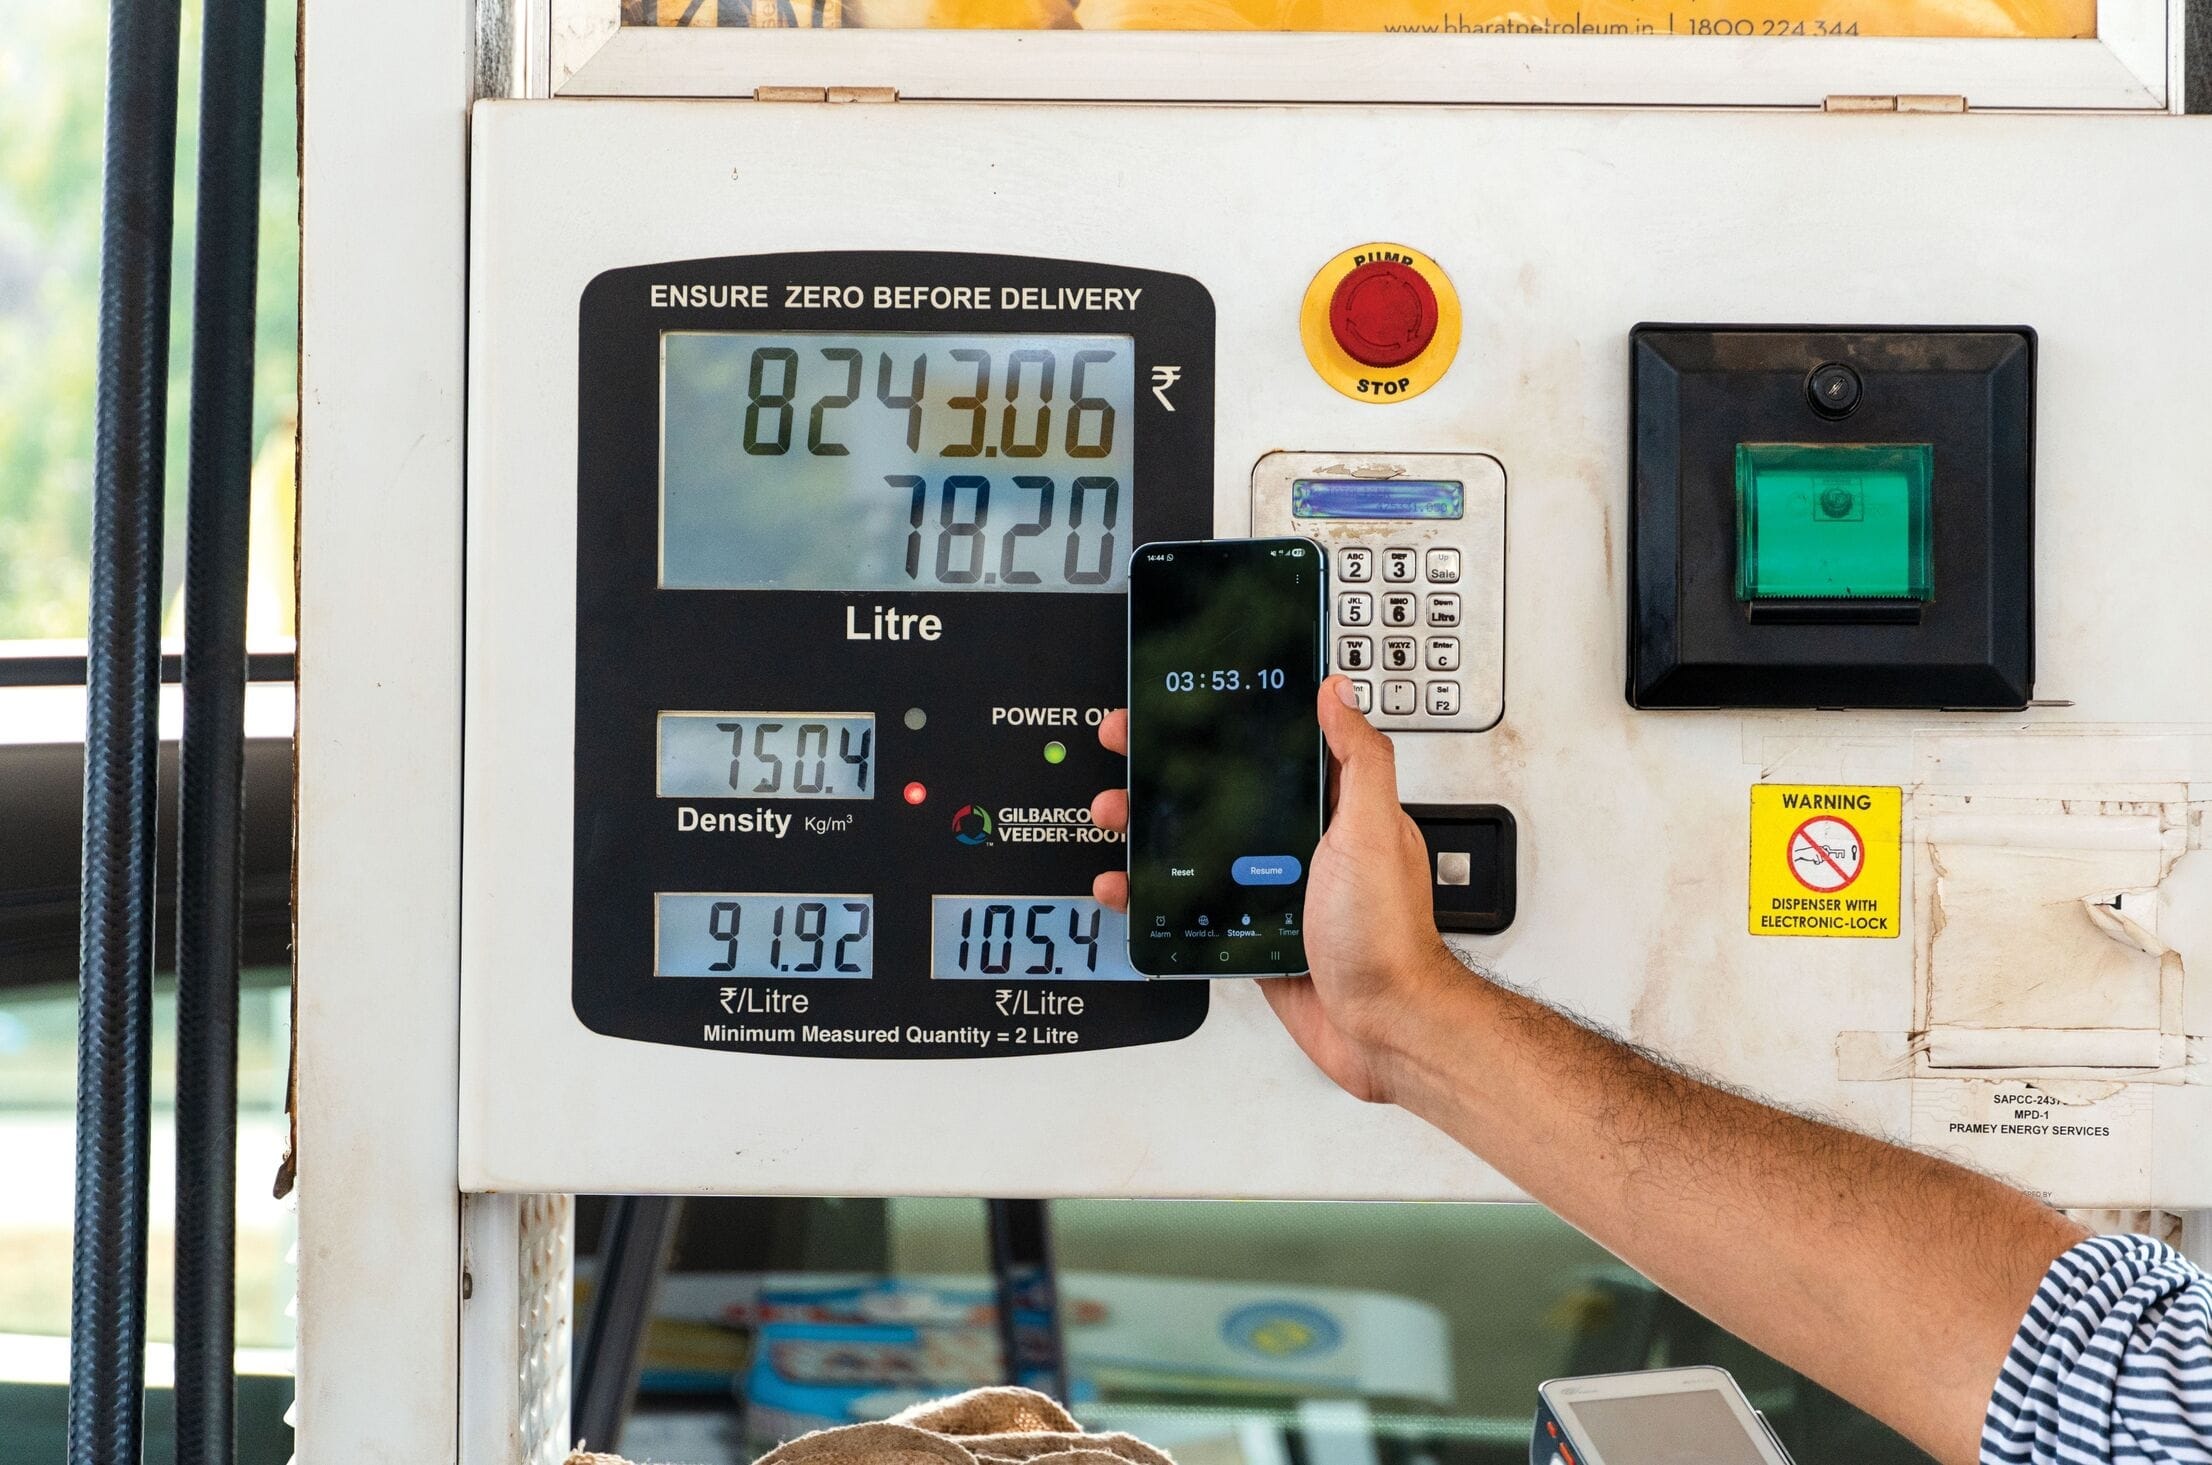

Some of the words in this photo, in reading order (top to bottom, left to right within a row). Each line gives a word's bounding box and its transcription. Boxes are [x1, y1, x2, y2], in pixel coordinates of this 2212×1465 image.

[1689, 18, 1754, 35] 1800
[1762, 19, 1806, 36] 224
[1814, 20, 1860, 36] 344
[650, 285, 769, 309] ENSURE
[785, 286, 865, 310] ZERO
[873, 287, 992, 311] BEFORE
[1000, 288, 1142, 312] DELIVERY
[1356, 377, 1410, 396] STOP
[742, 347, 1117, 459] 8243.06
[883, 475, 1120, 585] 78.20
[1438, 554, 1449, 562] Up
[1349, 561, 1361, 577] 2
[1393, 561, 1405, 577] 3
[1431, 568, 1456, 579] Sale
[1347, 597, 1363, 605] JKL
[1349, 606, 1361, 621] 5
[1392, 605, 1405, 622] 6
[1431, 612, 1455, 622] Litre
[846, 606, 943, 641] Litre
[1387, 641, 1411, 649] WXYZ
[1432, 641, 1454, 649] Enter
[1348, 649, 1361, 667] 8
[1392, 649, 1406, 666] 9
[1438, 656, 1448, 666] C
[1436, 701, 1450, 711] F2
[991, 706, 1078, 726] POWER
[1085, 706, 1116, 726] O
[715, 723, 872, 794] 750.4
[1782, 793, 1872, 810] WARNING
[677, 806, 792, 839] Density
[998, 807, 1091, 823] GILBARCO
[1171, 868, 1195, 877] Reset
[1250, 866, 1283, 876] Resume
[1772, 898, 1841, 911] DISPENSER
[1846, 899, 1877, 912] WITH
[1761, 915, 1888, 930] ELECTRONIC-LOCK
[706, 900, 868, 974] 91.92
[1150, 930, 1172, 938] Alarm
[1184, 929, 1206, 938] World
[1278, 928, 1300, 936] Timer
[703, 1023, 796, 1043] Minimum
[802, 1025, 900, 1044] Measured
[906, 1026, 991, 1047] Quantity
[997, 1032, 1010, 1043] =
[1015, 1027, 1027, 1044] 2
[1033, 1028, 1079, 1045] Litre
[2014, 1110, 2050, 1120] MPD-1
[1949, 1123, 1998, 1134] PRAMEY
[2000, 1124, 2050, 1136] ENERGY
[2051, 1126, 2111, 1137] SERVICES
